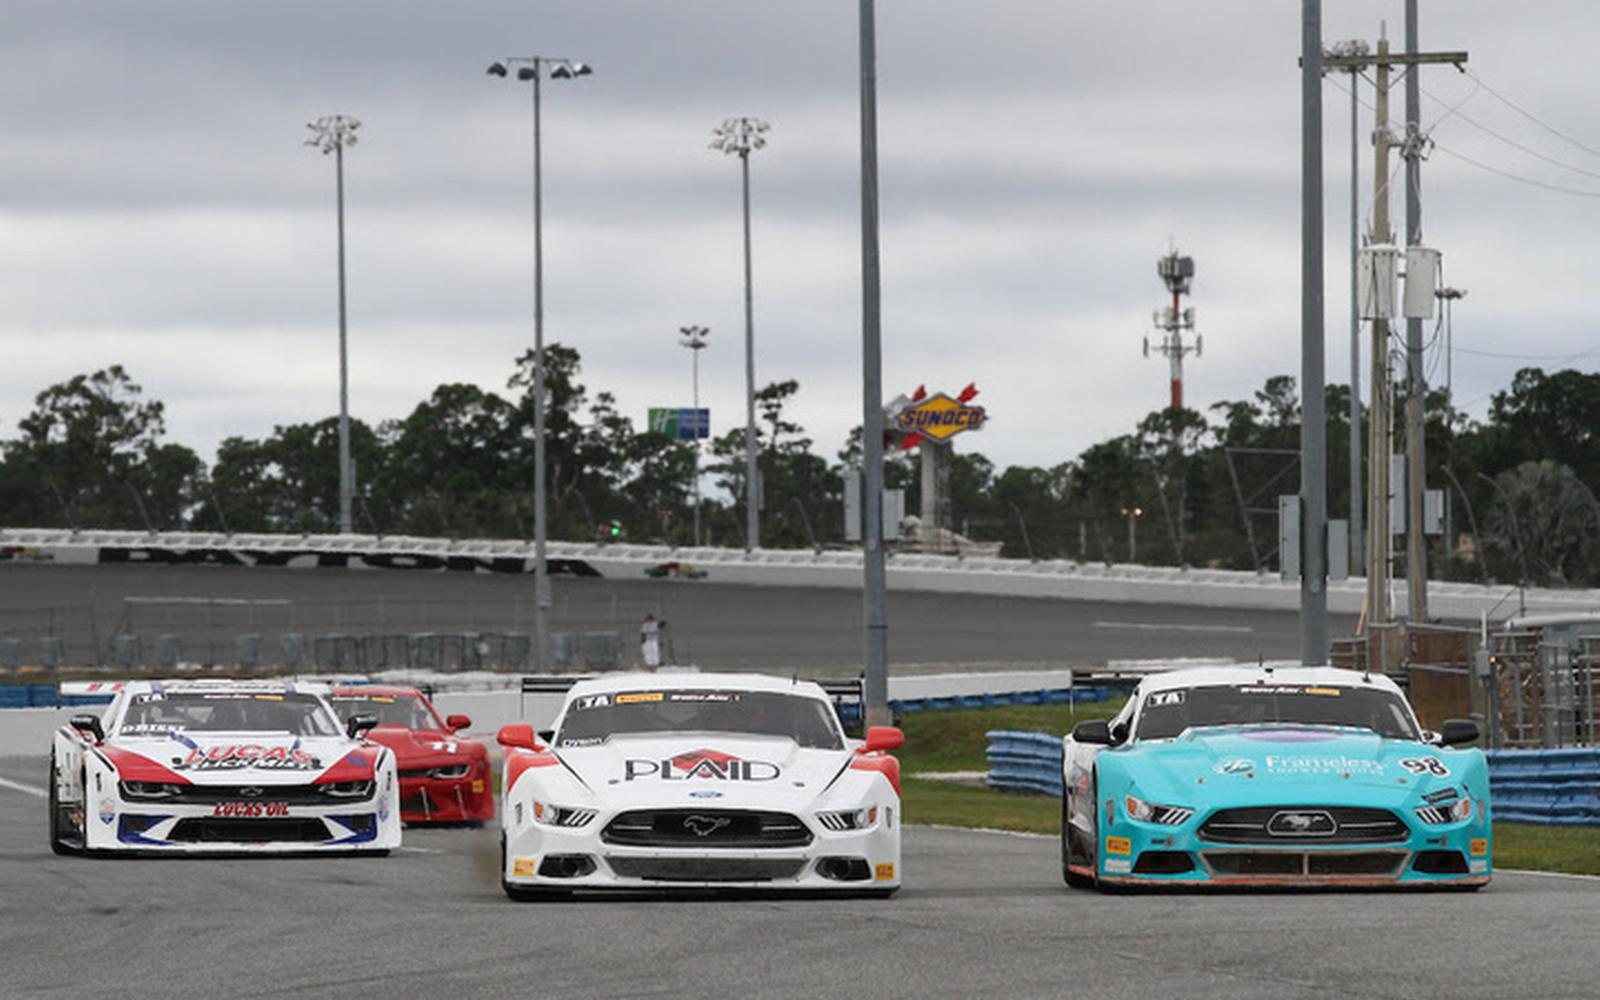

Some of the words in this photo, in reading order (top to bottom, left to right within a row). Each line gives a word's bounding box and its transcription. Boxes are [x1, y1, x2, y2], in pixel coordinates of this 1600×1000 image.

[903, 408, 981, 426] SUNOCO
[98, 547, 603, 577] DAYTONA
[584, 695, 609, 707] TA
[1154, 691, 1181, 704] TA
[186, 744, 312, 764] LUCAS
[1265, 754, 1384, 770] Frameless
[625, 759, 781, 781] PLAID
[1399, 756, 1449, 777] 98
[214, 803, 262, 816] LUCAS
[265, 803, 289, 816] OIL
